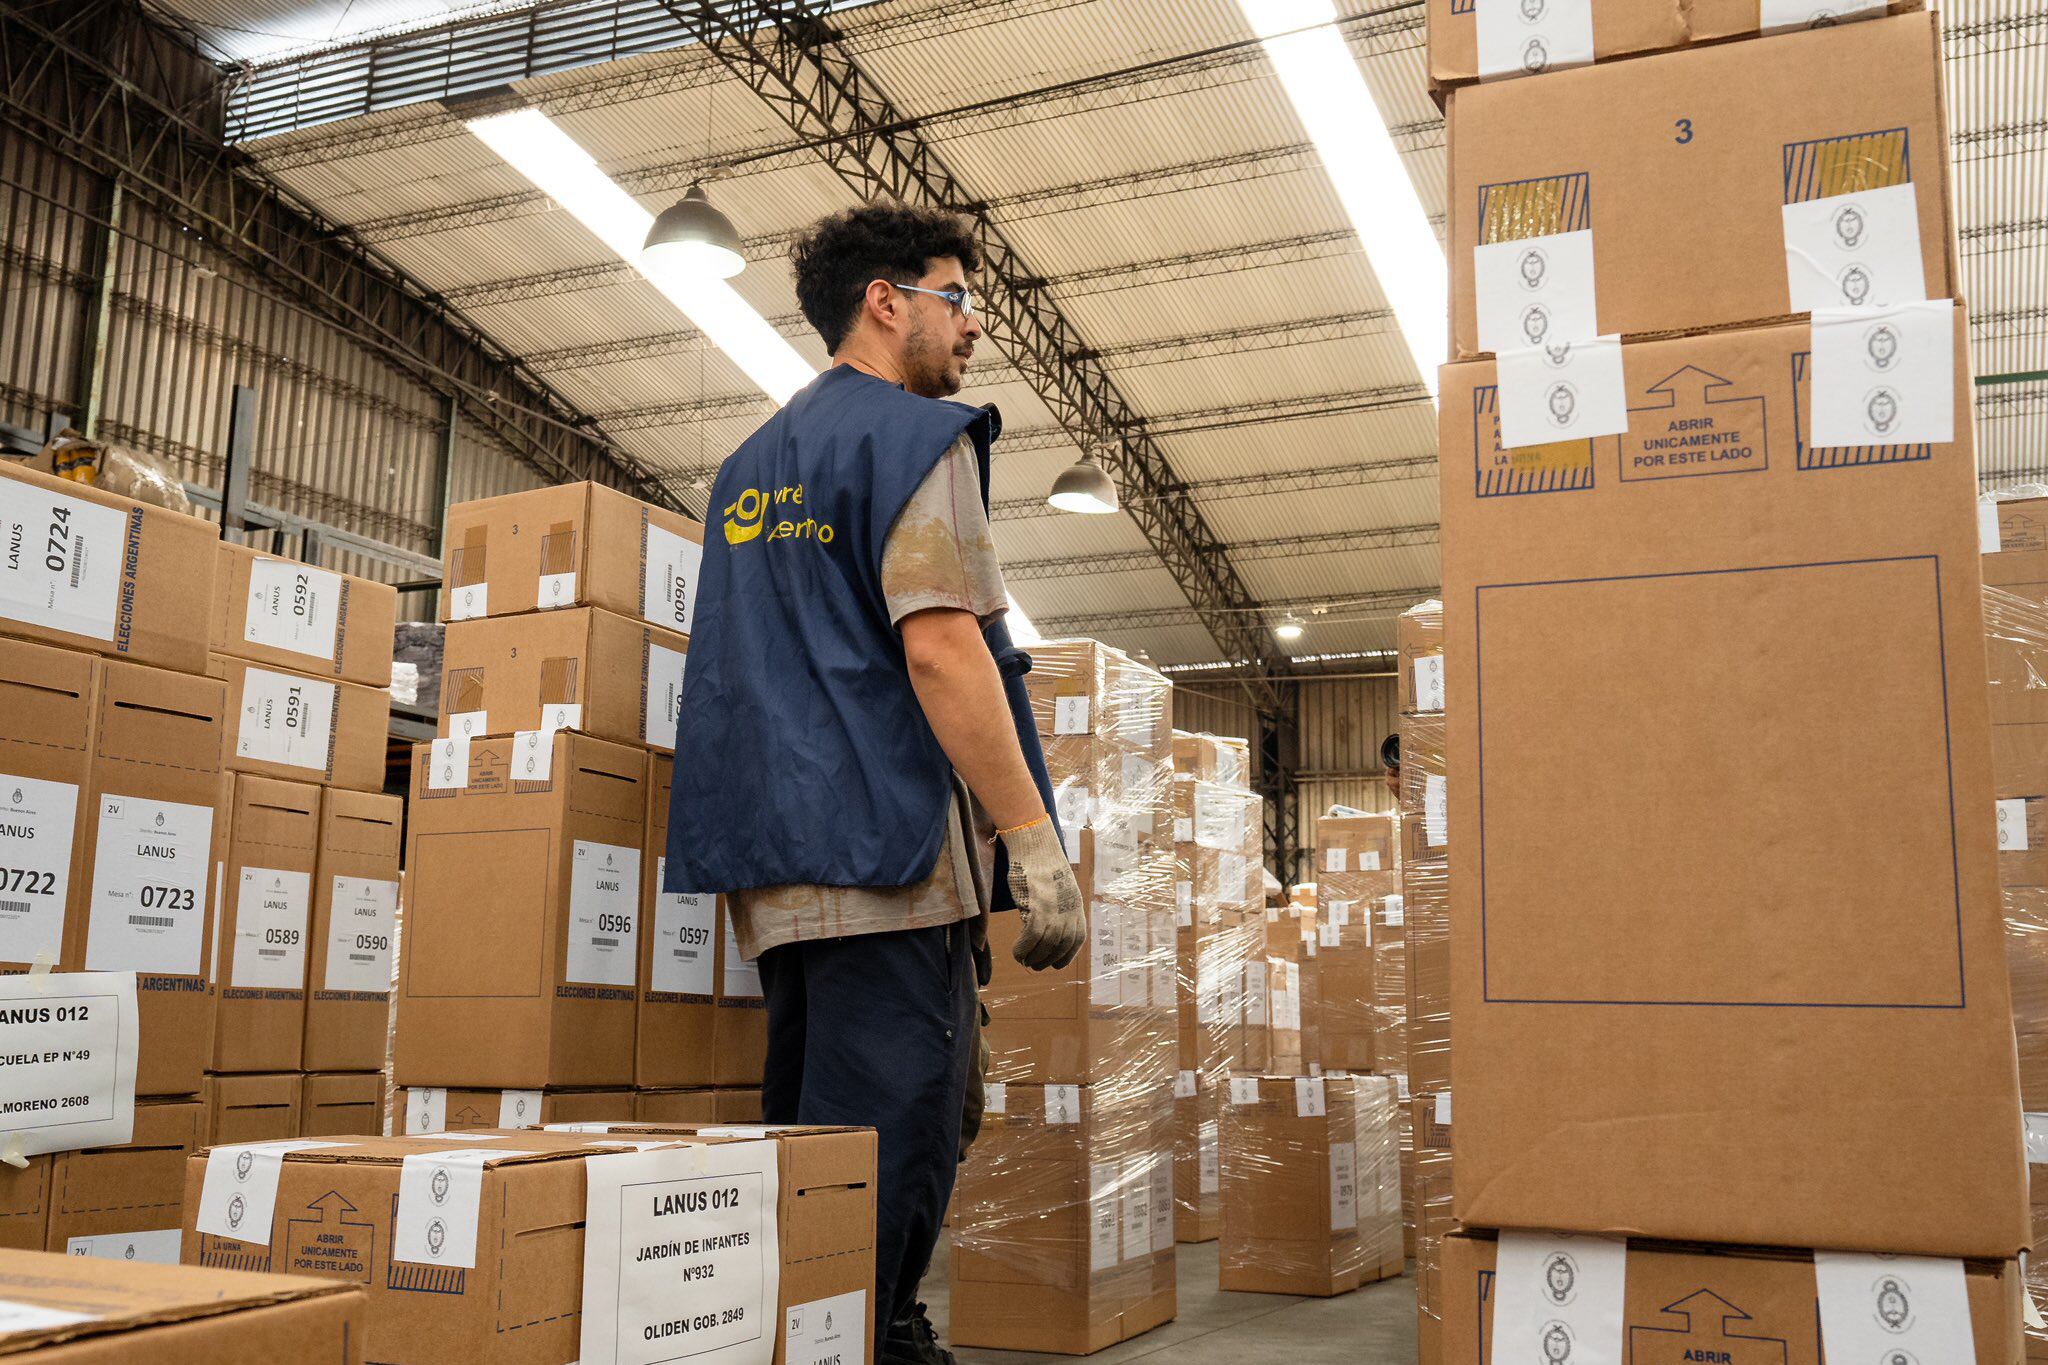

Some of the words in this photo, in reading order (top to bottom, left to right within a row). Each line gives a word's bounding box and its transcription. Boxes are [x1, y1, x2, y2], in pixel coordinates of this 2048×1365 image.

[1675, 118, 1694, 144] 3
[1668, 418, 1714, 432] ABRIR
[1643, 432, 1740, 451] UNICAMENTE
[1494, 456, 1508, 465] LA
[1634, 456, 1665, 468] POR
[1669, 451, 1706, 465] ESTE
[1710, 447, 1753, 462] LADO
[512, 524, 519, 535] 3
[640, 507, 649, 560] ELECCIONES
[8, 523, 24, 570] LANUS
[45, 506, 71, 572] 0724
[117, 582, 136, 653] ELECCIONES
[127, 506, 144, 579] ARGENTINAS
[293, 574, 309, 616] 0592
[638, 560, 648, 617] ARGENTINAS
[272, 585, 282, 616] LANUS
[338, 579, 350, 627] ARGENTINAS
[674, 576, 687, 623] 0600
[250, 626, 256, 636] 2V
[334, 629, 345, 674] ELECCIONES
[510, 648, 517, 659] 3
[640, 628, 650, 681] ELECCIONES
[264, 699, 273, 729] LANUS
[286, 686, 302, 728] 0591
[329, 685, 342, 732] ARGENTINAS
[638, 682, 648, 741] ARGENTINAS
[242, 742, 248, 751] 2V
[325, 733, 337, 781] ELECCIONES
[107, 804, 120, 814] 2V
[0, 823, 35, 839] ANUS
[137, 844, 176, 859] LANUS
[578, 848, 586, 856] 2V
[0, 868, 56, 895] 0722
[245, 873, 252, 881] 2V
[596, 880, 620, 892] LANUS
[108, 890, 123, 898] Mesa
[141, 886, 194, 910] 0723
[264, 900, 288, 910] LANUS
[677, 895, 698, 906] LANUS
[354, 908, 377, 917] LANUS
[598, 913, 632, 934] 0596
[266, 928, 300, 945] 0589
[356, 934, 388, 950] 0590
[679, 926, 709, 946] 0597
[143, 977, 205, 992] ARGENTINAS
[223, 989, 263, 1000] ELECCIONES
[265, 989, 303, 1001] ARGENTINAS
[314, 991, 349, 1000] ELECCIONES
[353, 991, 388, 1001] ARGENTINAS
[556, 985, 596, 1000] ELECCIONES
[597, 987, 635, 1002] ARGENTINAS
[0, 1008, 50, 1025] ANUS
[56, 1006, 89, 1022] 012
[0, 1054, 39, 1066] CUELA
[43, 1052, 59, 1063] EP
[63, 1050, 90, 1062] N°49
[0, 1098, 57, 1114] .MORENO
[61, 1096, 89, 1109] 2608
[653, 1190, 707, 1217] LANUS
[712, 1187, 739, 1209] 012
[223, 1242, 241, 1251] URNA
[316, 1234, 344, 1245] ABRIR
[636, 1239, 681, 1262] JARDÍN
[684, 1239, 699, 1255] DE
[702, 1231, 750, 1252] INFANTES
[75, 1247, 88, 1256] 2V
[301, 1246, 358, 1259] UNICAMENTE
[294, 1259, 312, 1270] POR
[314, 1259, 338, 1271] ESTE
[339, 1260, 363, 1273] LADO
[643, 1318, 690, 1341] OLIDEN
[693, 1314, 719, 1333] GOB.
[721, 1307, 744, 1325] 2849
[791, 1318, 800, 1330] 2V
[1683, 1348, 1732, 1365] ABRIR
